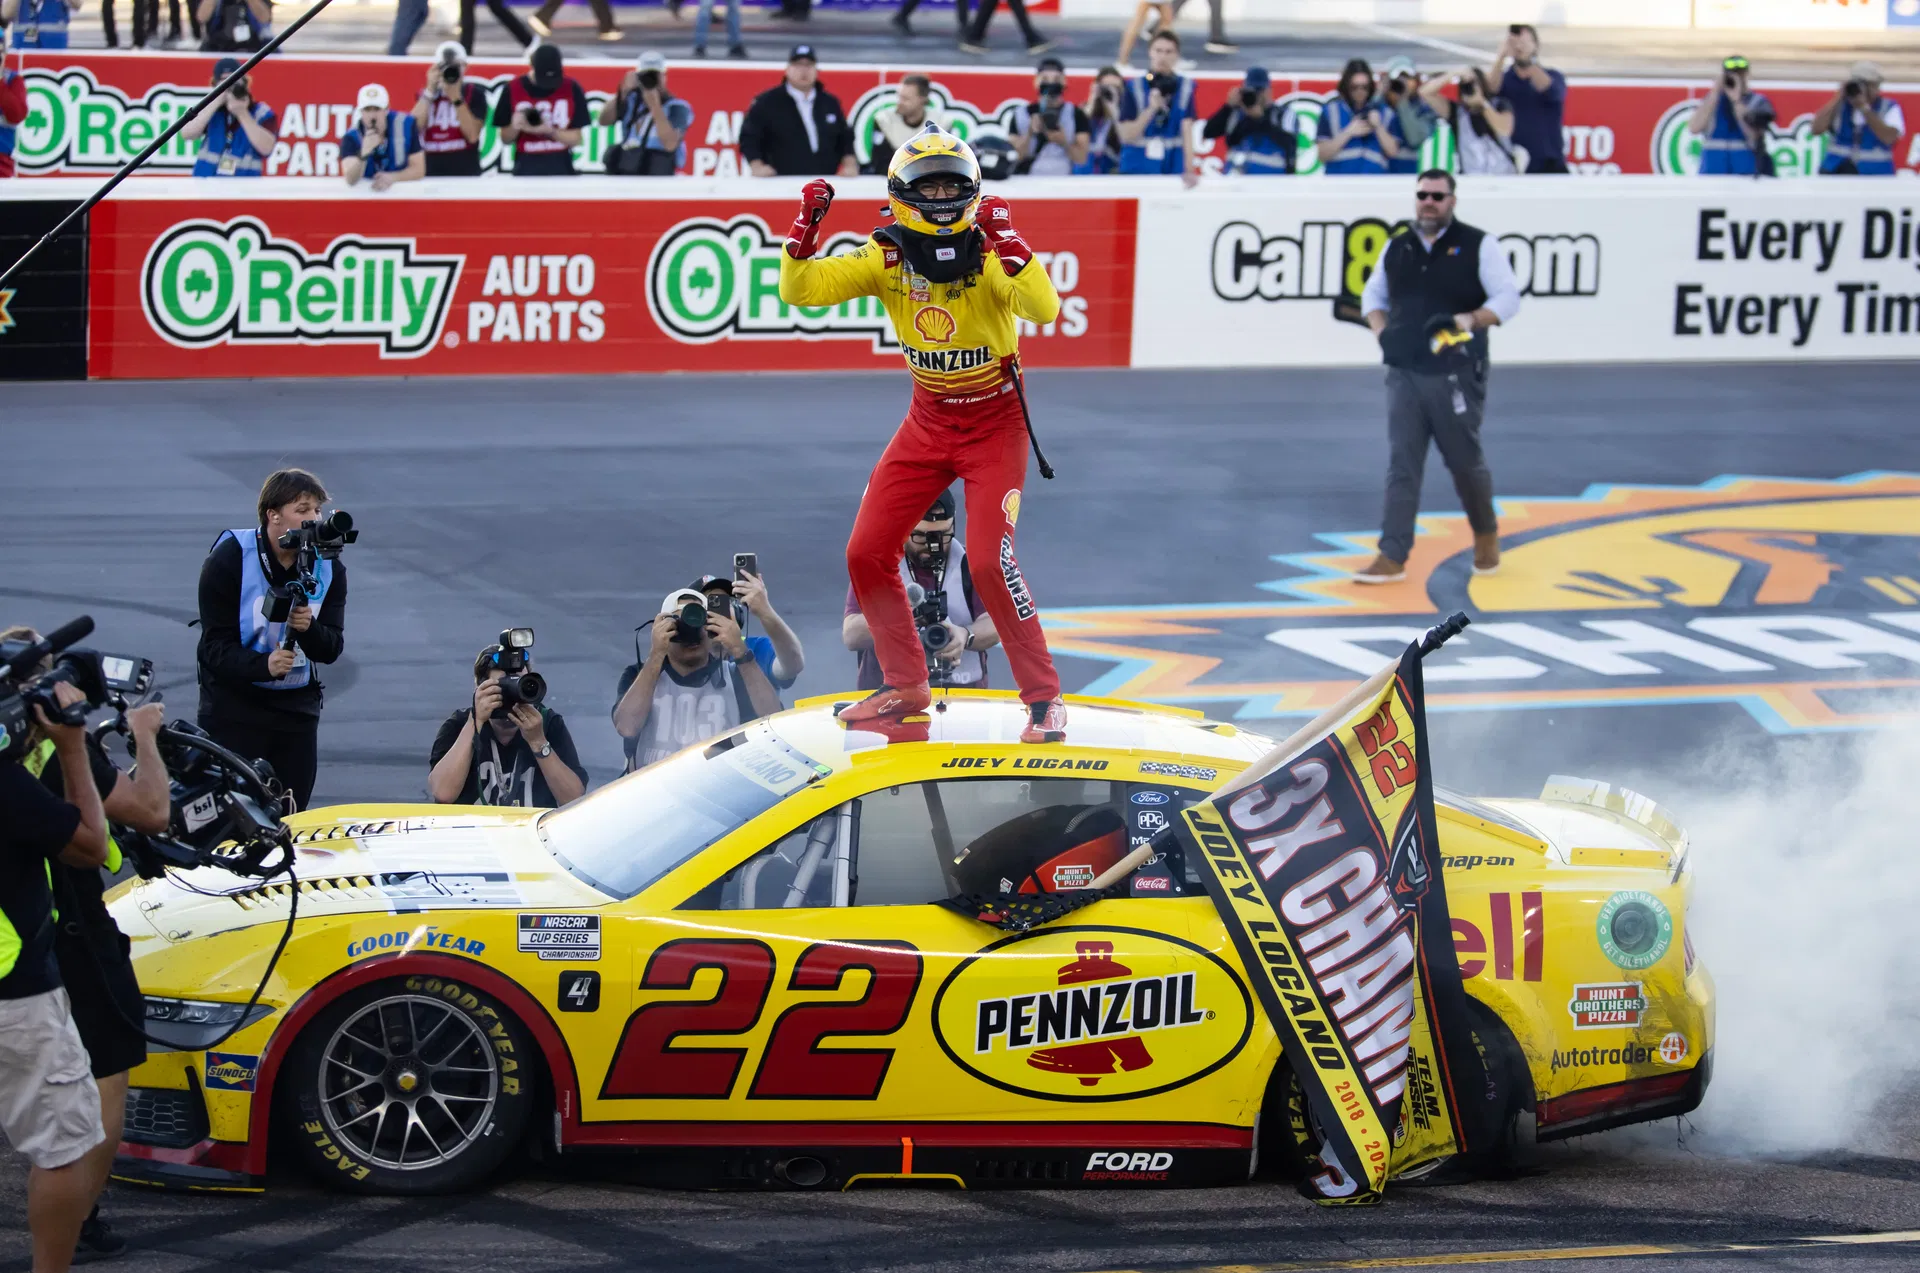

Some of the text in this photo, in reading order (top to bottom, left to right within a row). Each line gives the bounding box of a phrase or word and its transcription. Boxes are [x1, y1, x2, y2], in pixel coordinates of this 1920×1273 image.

[16, 84, 204, 157] O'Reil
[280, 103, 361, 140] AUT
[267, 142, 342, 176] PAR
[1698, 208, 1920, 272] Every Di
[160, 237, 437, 337] O'Reilly
[482, 254, 595, 297] AUTO
[467, 301, 606, 342] PARTS
[1674, 284, 1820, 347] Every
[901, 340, 994, 372] PENNZOIL
[1265, 614, 1920, 682] CHA
[653, 693, 727, 744] 103
[941, 757, 1110, 771] JOEY LOGANO
[1351, 701, 1418, 799] 22
[1137, 792, 1163, 803] Ford
[1140, 812, 1162, 827] PPG
[1228, 757, 1346, 881] 3X
[1440, 853, 1515, 870] nap-on
[543, 915, 588, 929] NASCAR
[1601, 902, 1615, 920] GET
[529, 932, 590, 944] CUP SERIES
[1449, 891, 1544, 982] ell
[541, 950, 599, 960] CHAMPIONSHIP
[1187, 809, 1264, 907] JOEY
[1247, 920, 1346, 1070] LOGANO
[1335, 1081, 1365, 1121] 2018
[567, 976, 590, 1006] 4
[1574, 999, 1641, 1012] BROTHERS
[1589, 988, 1626, 1001] HUNT
[597, 937, 925, 1101] 22
[976, 972, 1204, 1052] PENNZOIL
[1588, 1010, 1627, 1023] PIZZA
[207, 1066, 255, 1080] SUNOCO
[1550, 1042, 1657, 1070] Autotrader
[1416, 1054, 1441, 1118] TEAM
[304, 1119, 372, 1182] EAGLE
[1085, 1151, 1174, 1171] FORD
[1082, 1172, 1169, 1181] PERFORMANCE
